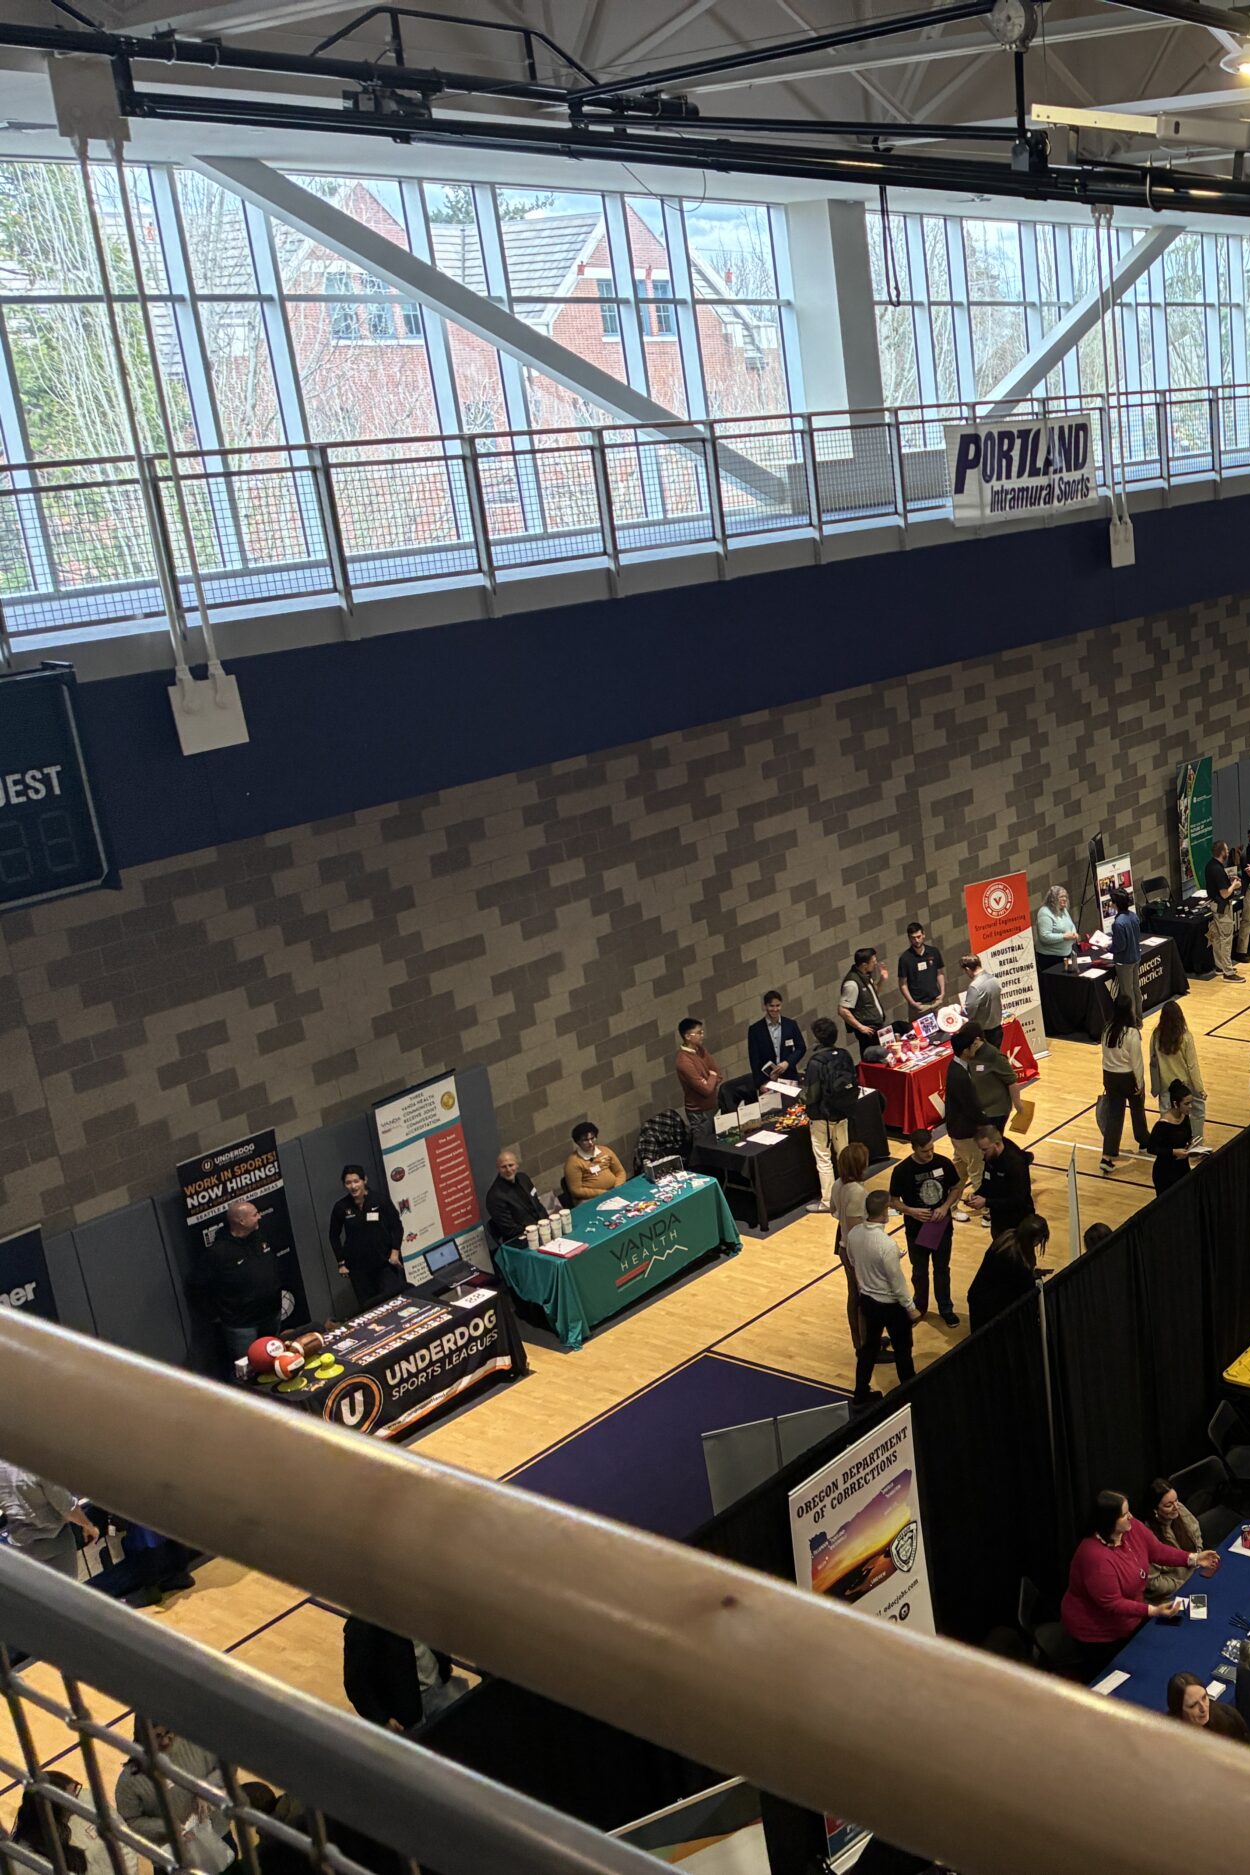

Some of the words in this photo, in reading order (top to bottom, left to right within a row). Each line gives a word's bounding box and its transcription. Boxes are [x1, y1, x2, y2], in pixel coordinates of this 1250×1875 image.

[954, 423, 1088, 494] PORTLAND
[990, 482, 1055, 513] Intramural
[1057, 474, 1090, 505] Sports
[991, 944, 1024, 958] INDUSTRIAL
[992, 962, 1034, 978] NUFACTURING
[999, 956, 1019, 967] RETAIL
[1001, 977, 1021, 988] OFFICE
[184, 1174, 219, 1196] WORK
[220, 1168, 232, 1182] IN
[234, 1150, 277, 1176] SPORTS!
[214, 1143, 255, 1164] UNDERDOG
[186, 1185, 223, 1209] NOW
[227, 1161, 279, 1192] HIRING!
[195, 1204, 222, 1222] SEATTLE
[610, 1212, 682, 1261] VANDA
[620, 1229, 677, 1272] HEALTH
[386, 1309, 497, 1386] UNDERDOG
[392, 1362, 441, 1401] SPORTS
[445, 1328, 499, 1370] LEAGUES
[341, 1389, 364, 1426] U
[797, 1478, 839, 1519] OREGON
[841, 1426, 908, 1485] DEPARTMENT
[813, 1504, 827, 1524] OF
[830, 1450, 898, 1509] CORRECTIONS
